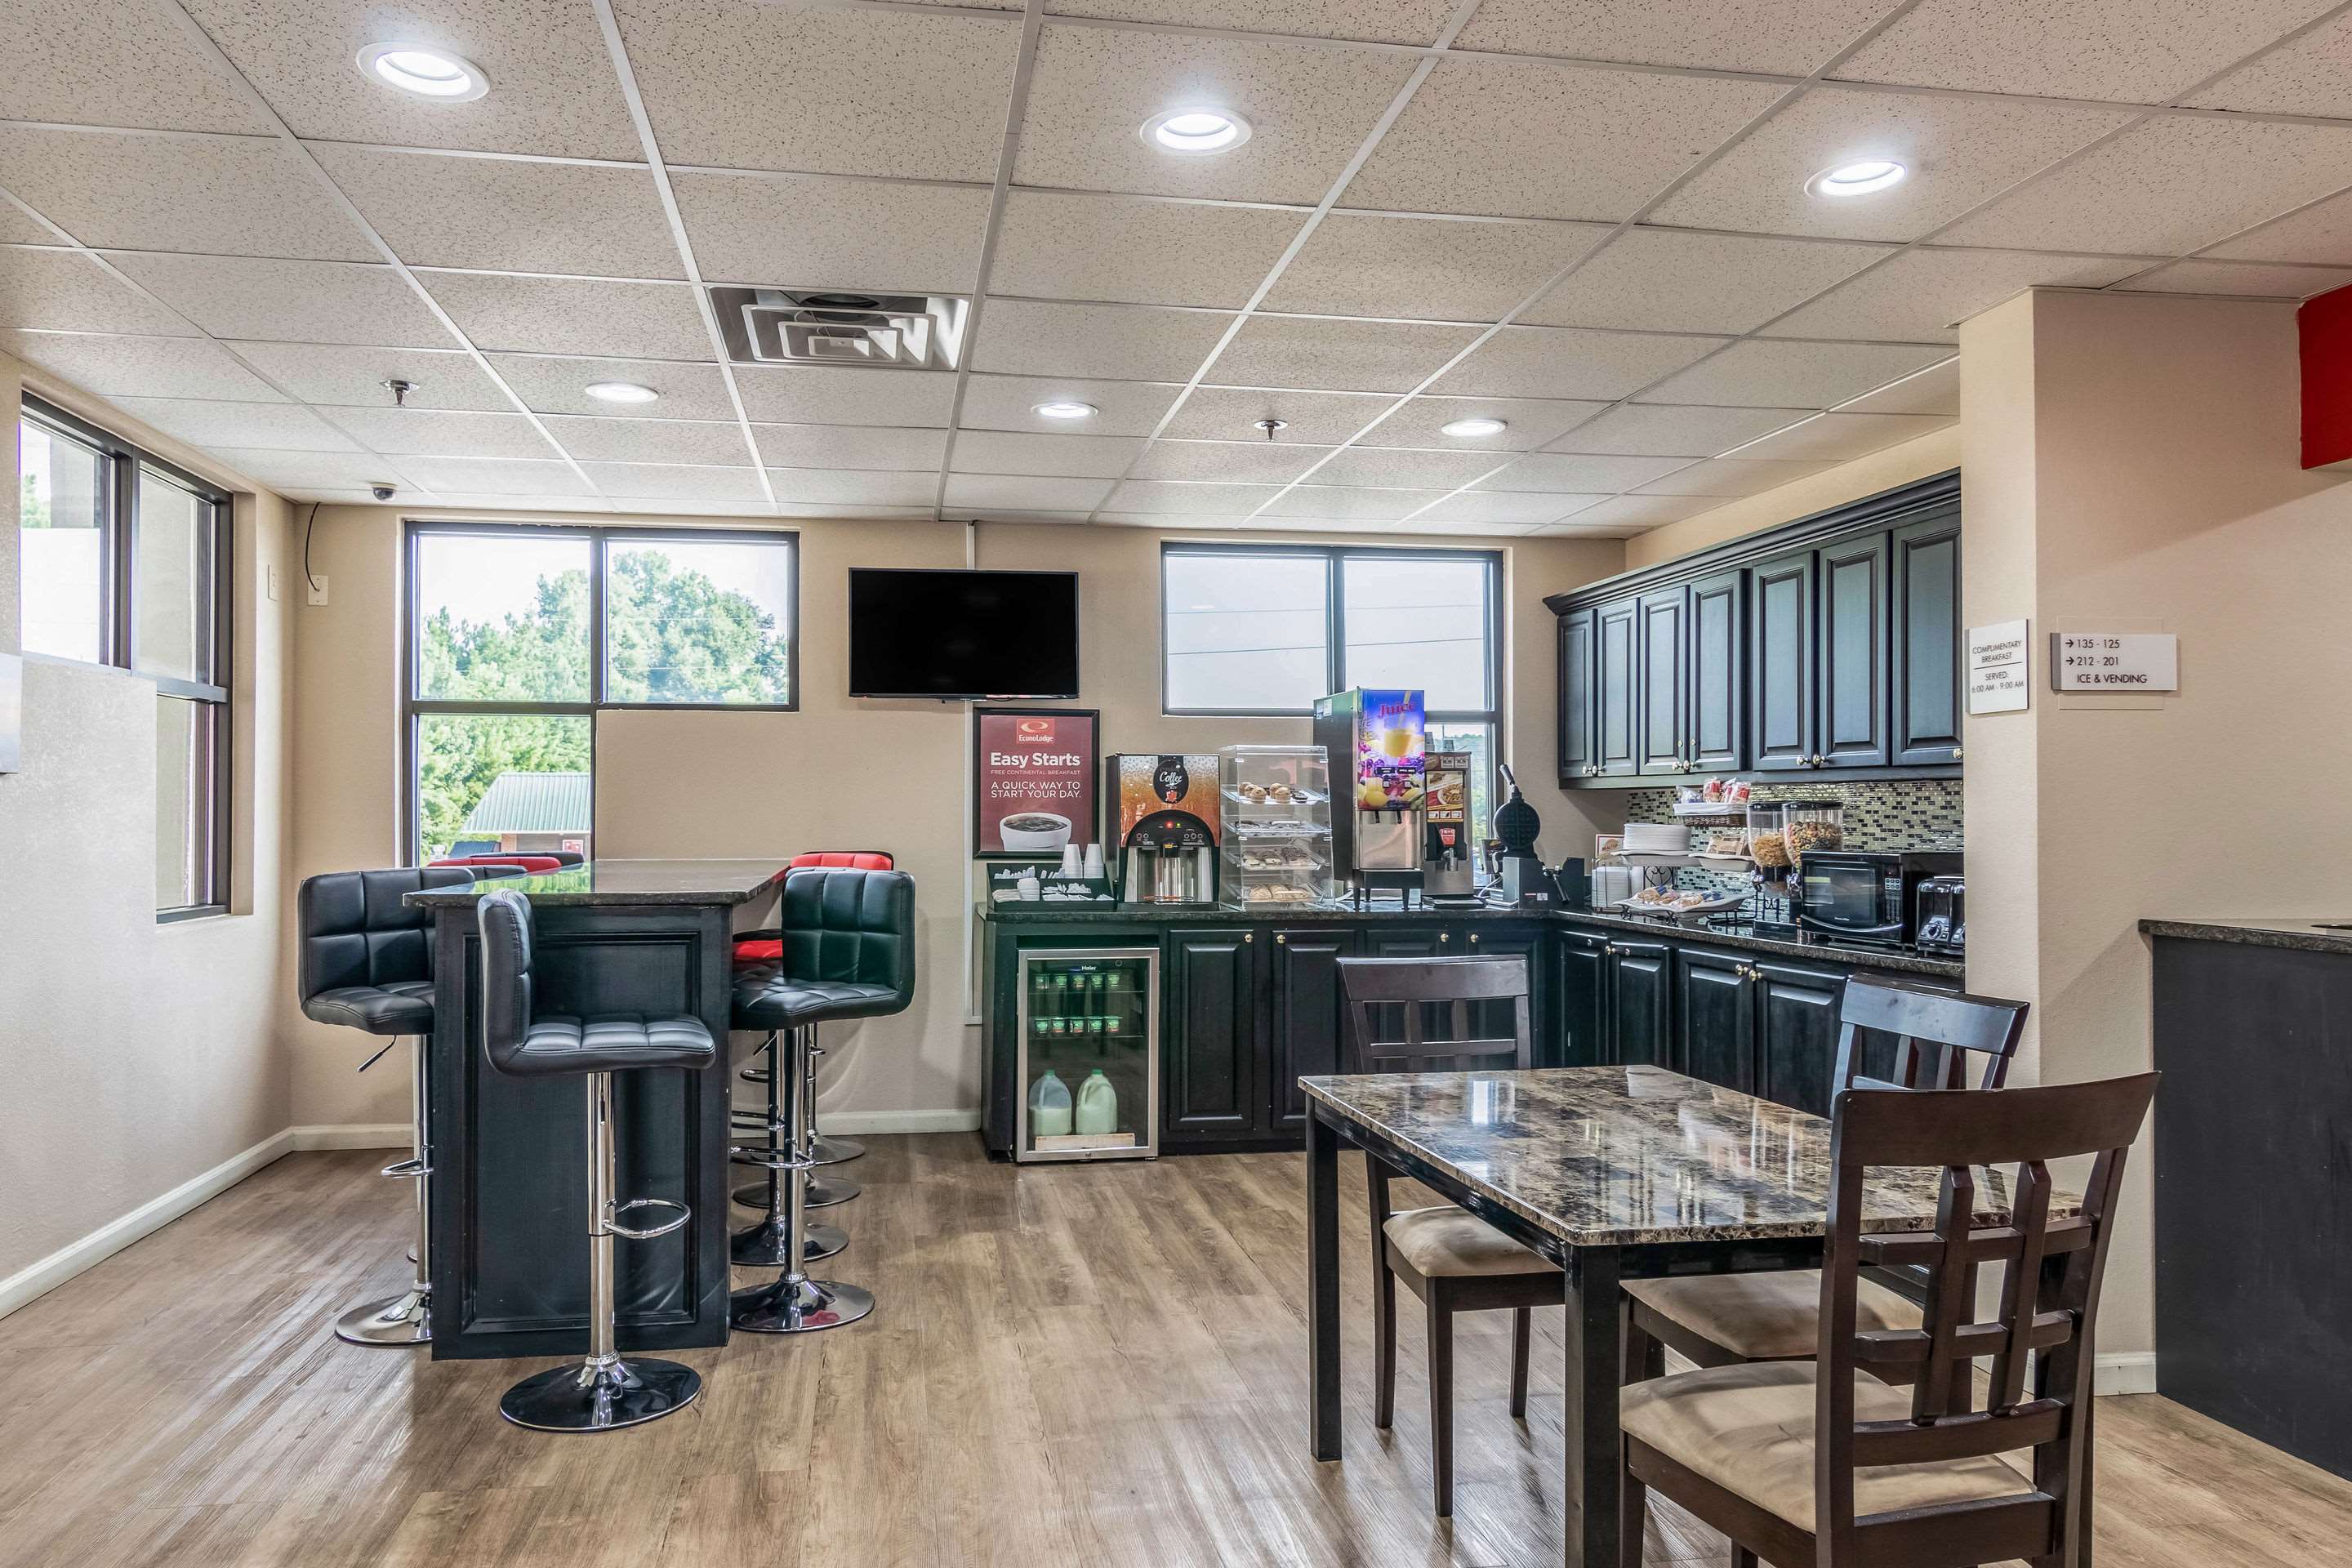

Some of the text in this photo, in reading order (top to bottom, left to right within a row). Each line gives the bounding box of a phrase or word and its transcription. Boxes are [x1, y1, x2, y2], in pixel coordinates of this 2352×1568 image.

[1972, 640, 2022, 654] COMPLIMENTARY
[2077, 639, 2094, 648] 135
[2103, 639, 2120, 648] 125
[1981, 652, 2012, 663] BREAKFAST
[2077, 657, 2094, 666] 212
[2103, 657, 2119, 666] 201
[2077, 674, 2148, 683] ICE & VENDING
[1378, 702, 1417, 718] Juice
[990, 751, 1080, 768] Easy Starts
[1160, 771, 1183, 786] Coffee
[991, 782, 1080, 790] A QUICK WAY TO
[991, 790, 1081, 798] START YOUR DAY.
